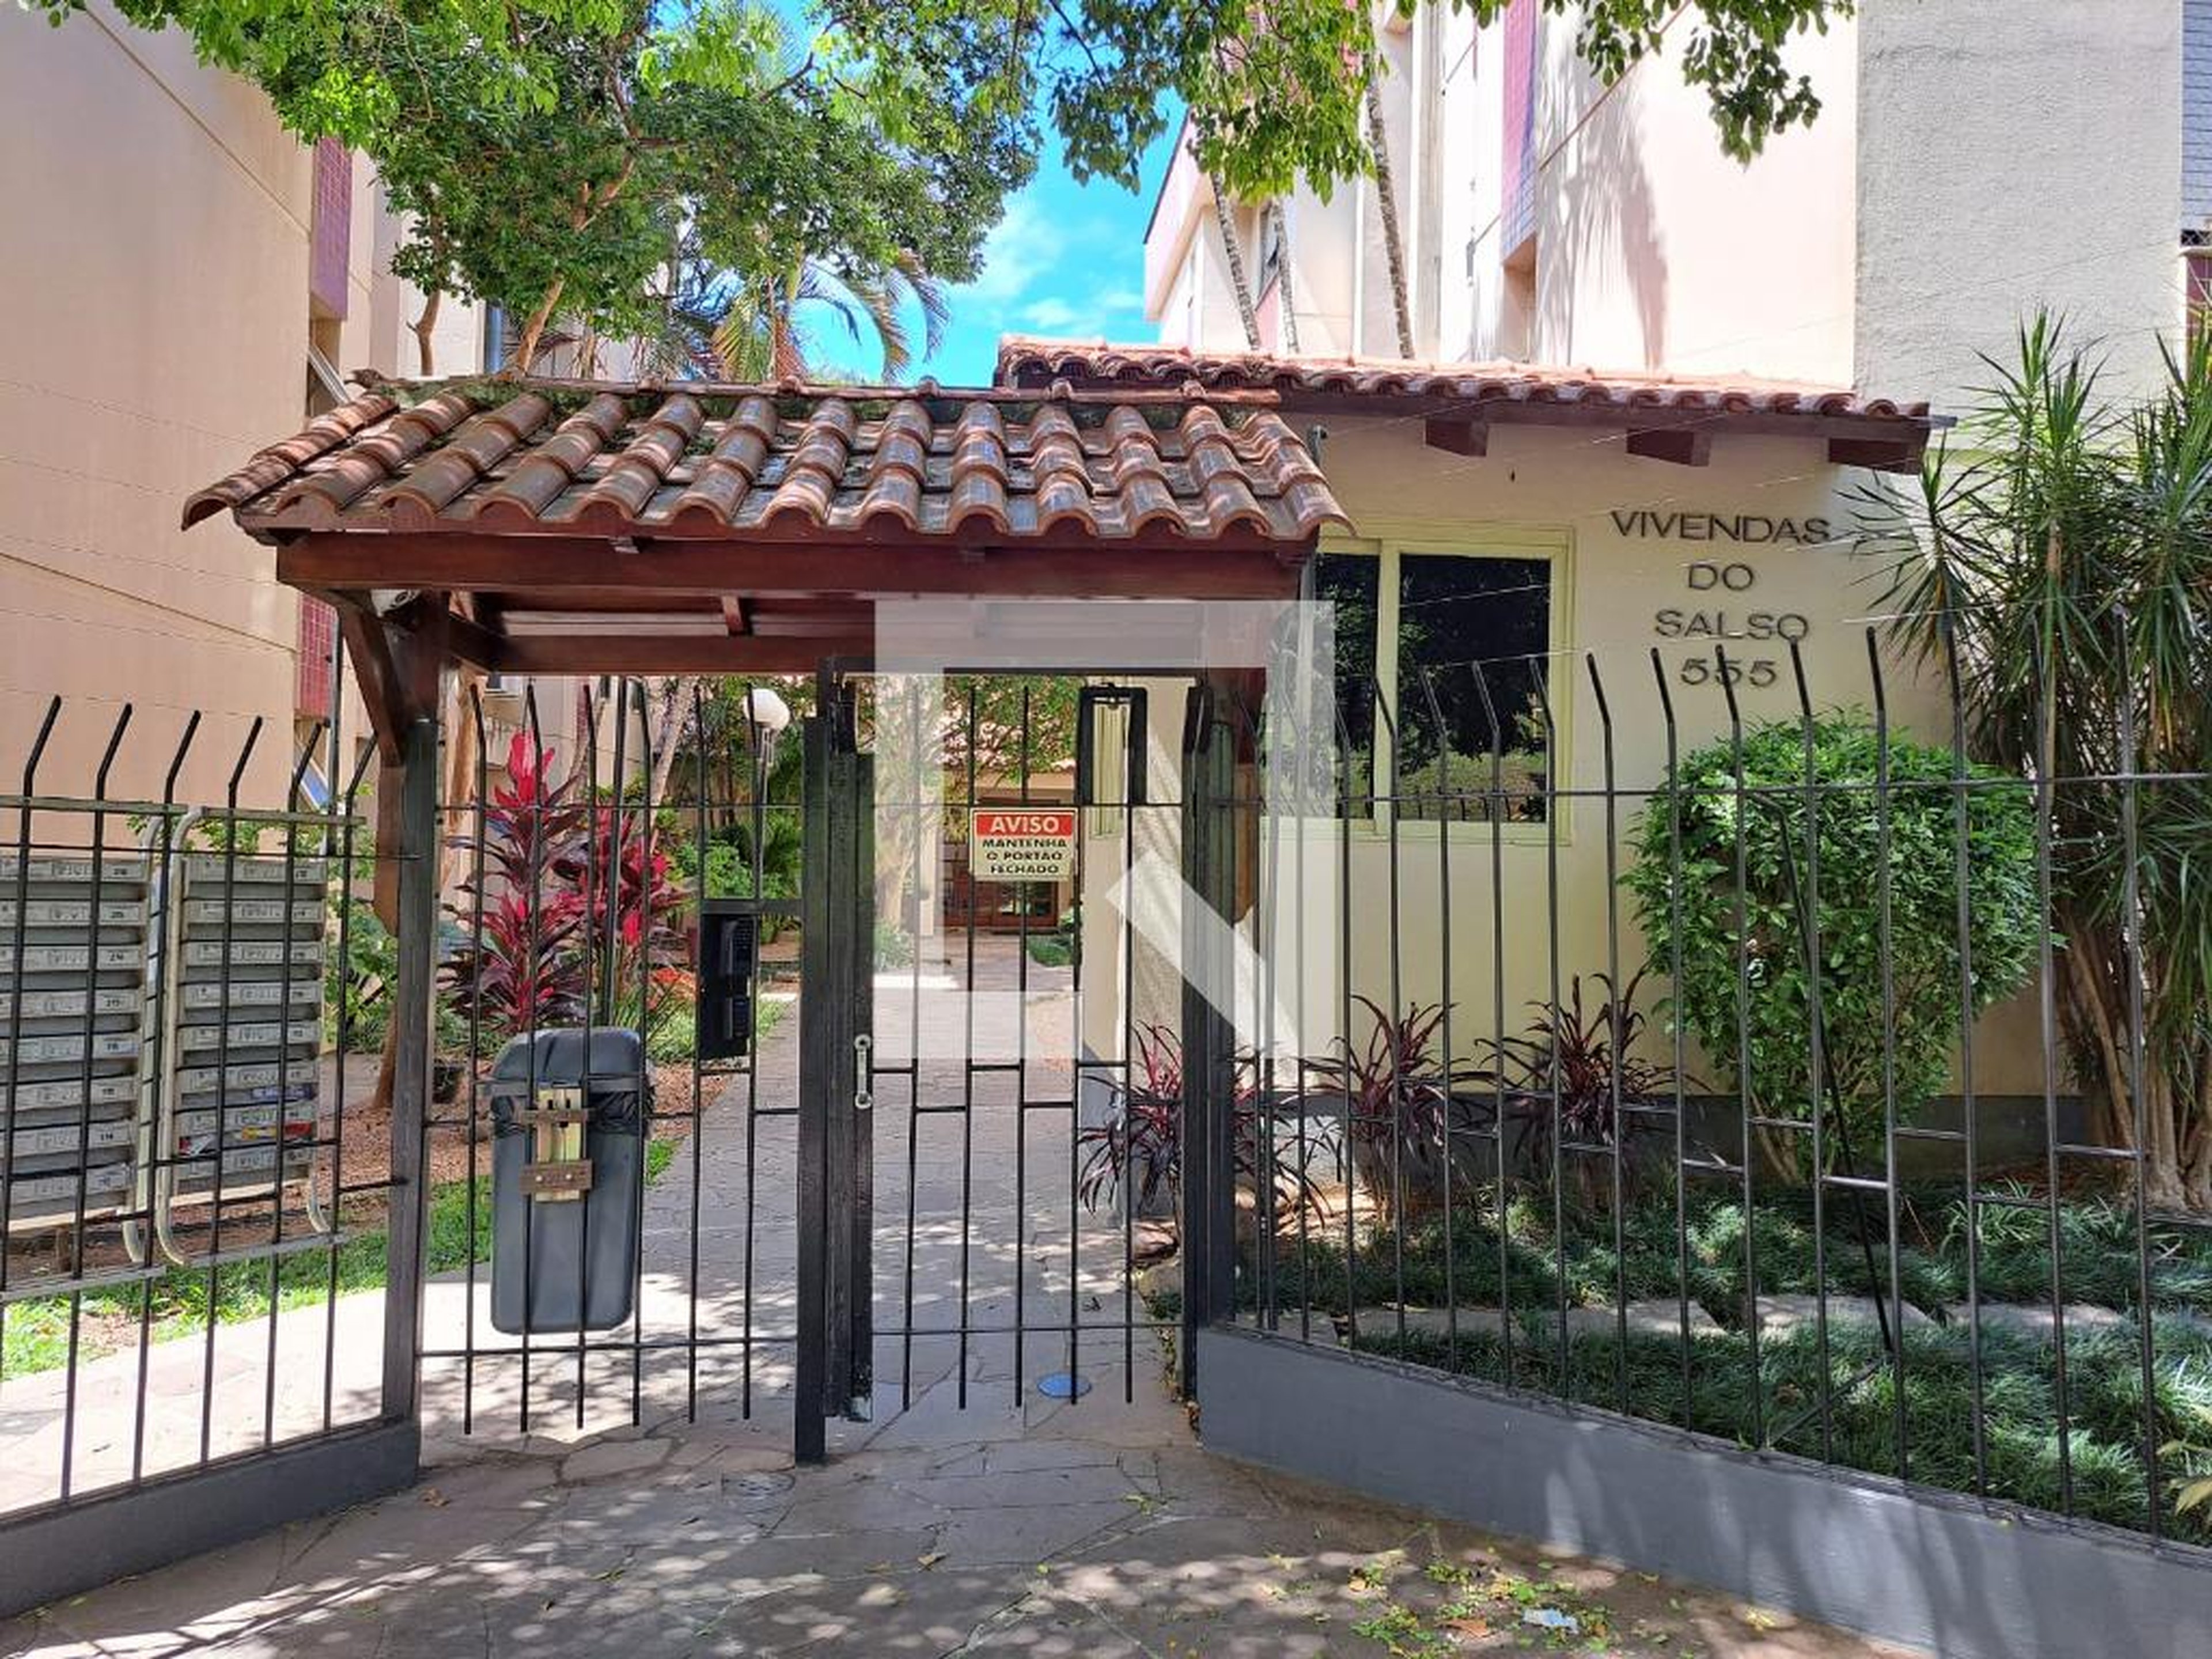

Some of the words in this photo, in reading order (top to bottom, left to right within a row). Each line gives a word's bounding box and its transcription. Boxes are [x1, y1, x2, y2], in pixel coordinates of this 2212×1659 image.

[1611, 510, 1830, 544] VIVENDAS
[1688, 563, 1754, 590] DO
[1654, 609, 1809, 640] SALSO
[1680, 657, 1777, 687] 555
[990, 816, 1059, 833] AVISO
[983, 839, 1067, 847] MANTENHA
[986, 851, 998, 860] O
[991, 865, 1059, 874] FECHADO
